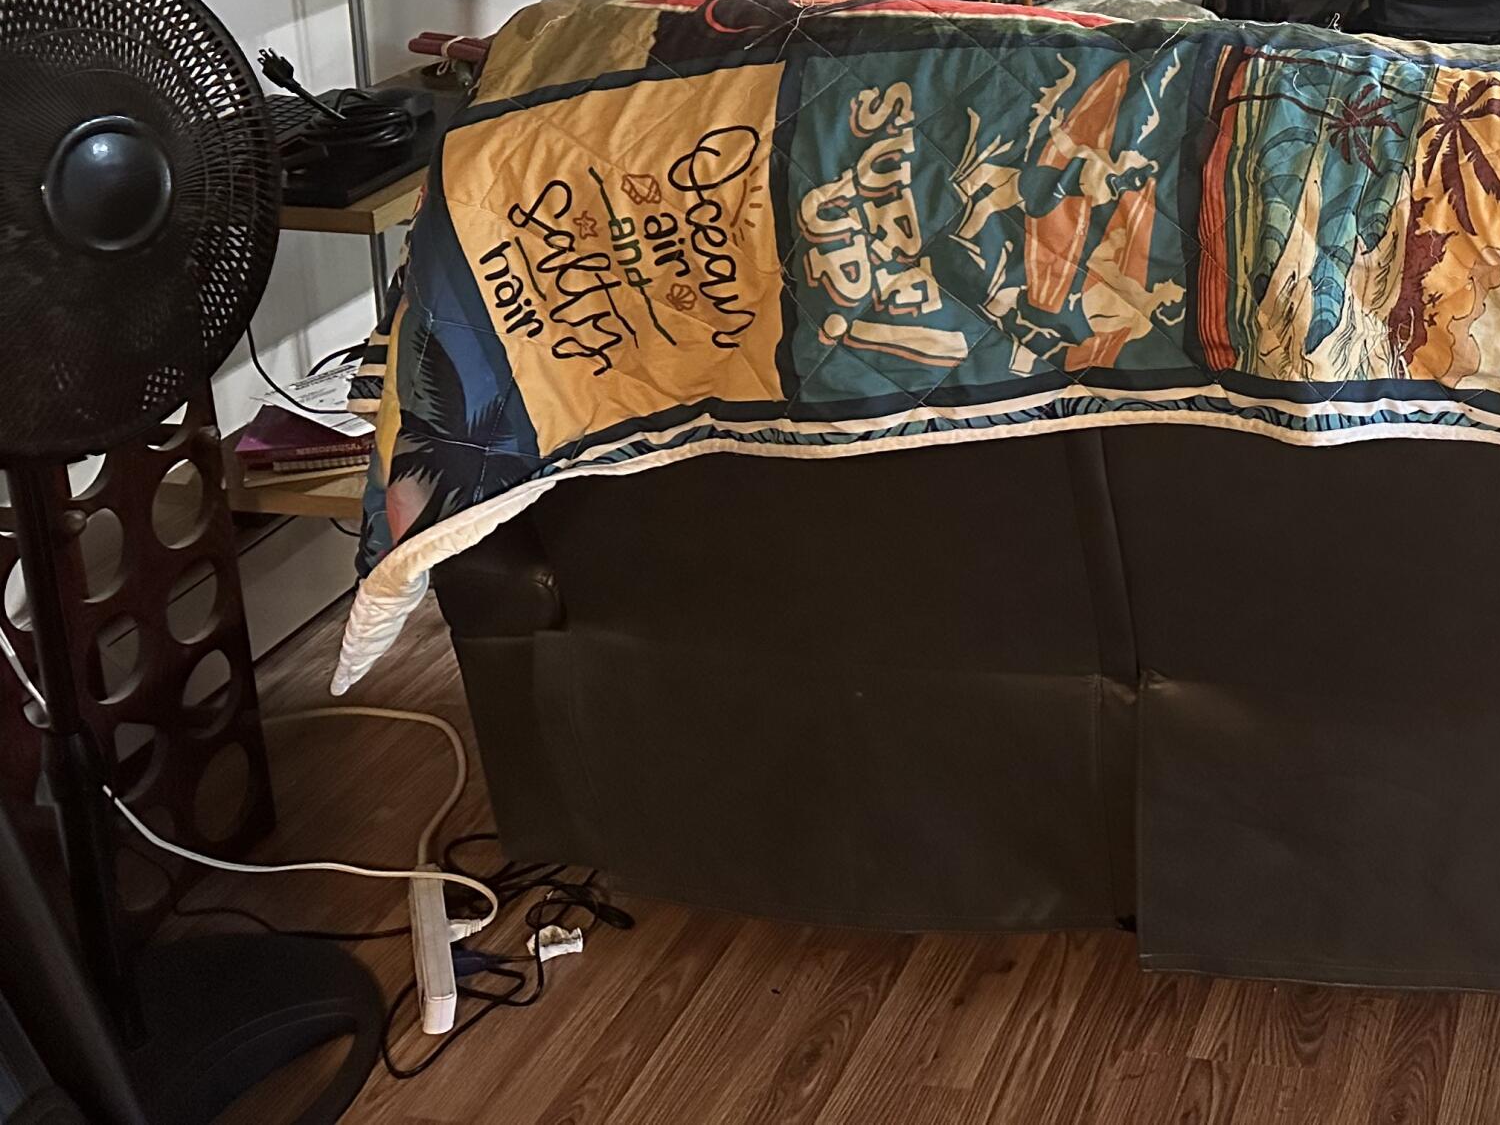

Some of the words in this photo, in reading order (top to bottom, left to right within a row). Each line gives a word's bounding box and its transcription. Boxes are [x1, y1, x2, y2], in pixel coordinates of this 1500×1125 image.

[608, 216, 653, 288] and
[643, 211, 691, 277] air
[667, 125, 760, 348] Ocean
[798, 170, 969, 365] UP!
[852, 81, 943, 315] SURF
[479, 241, 544, 338] hair
